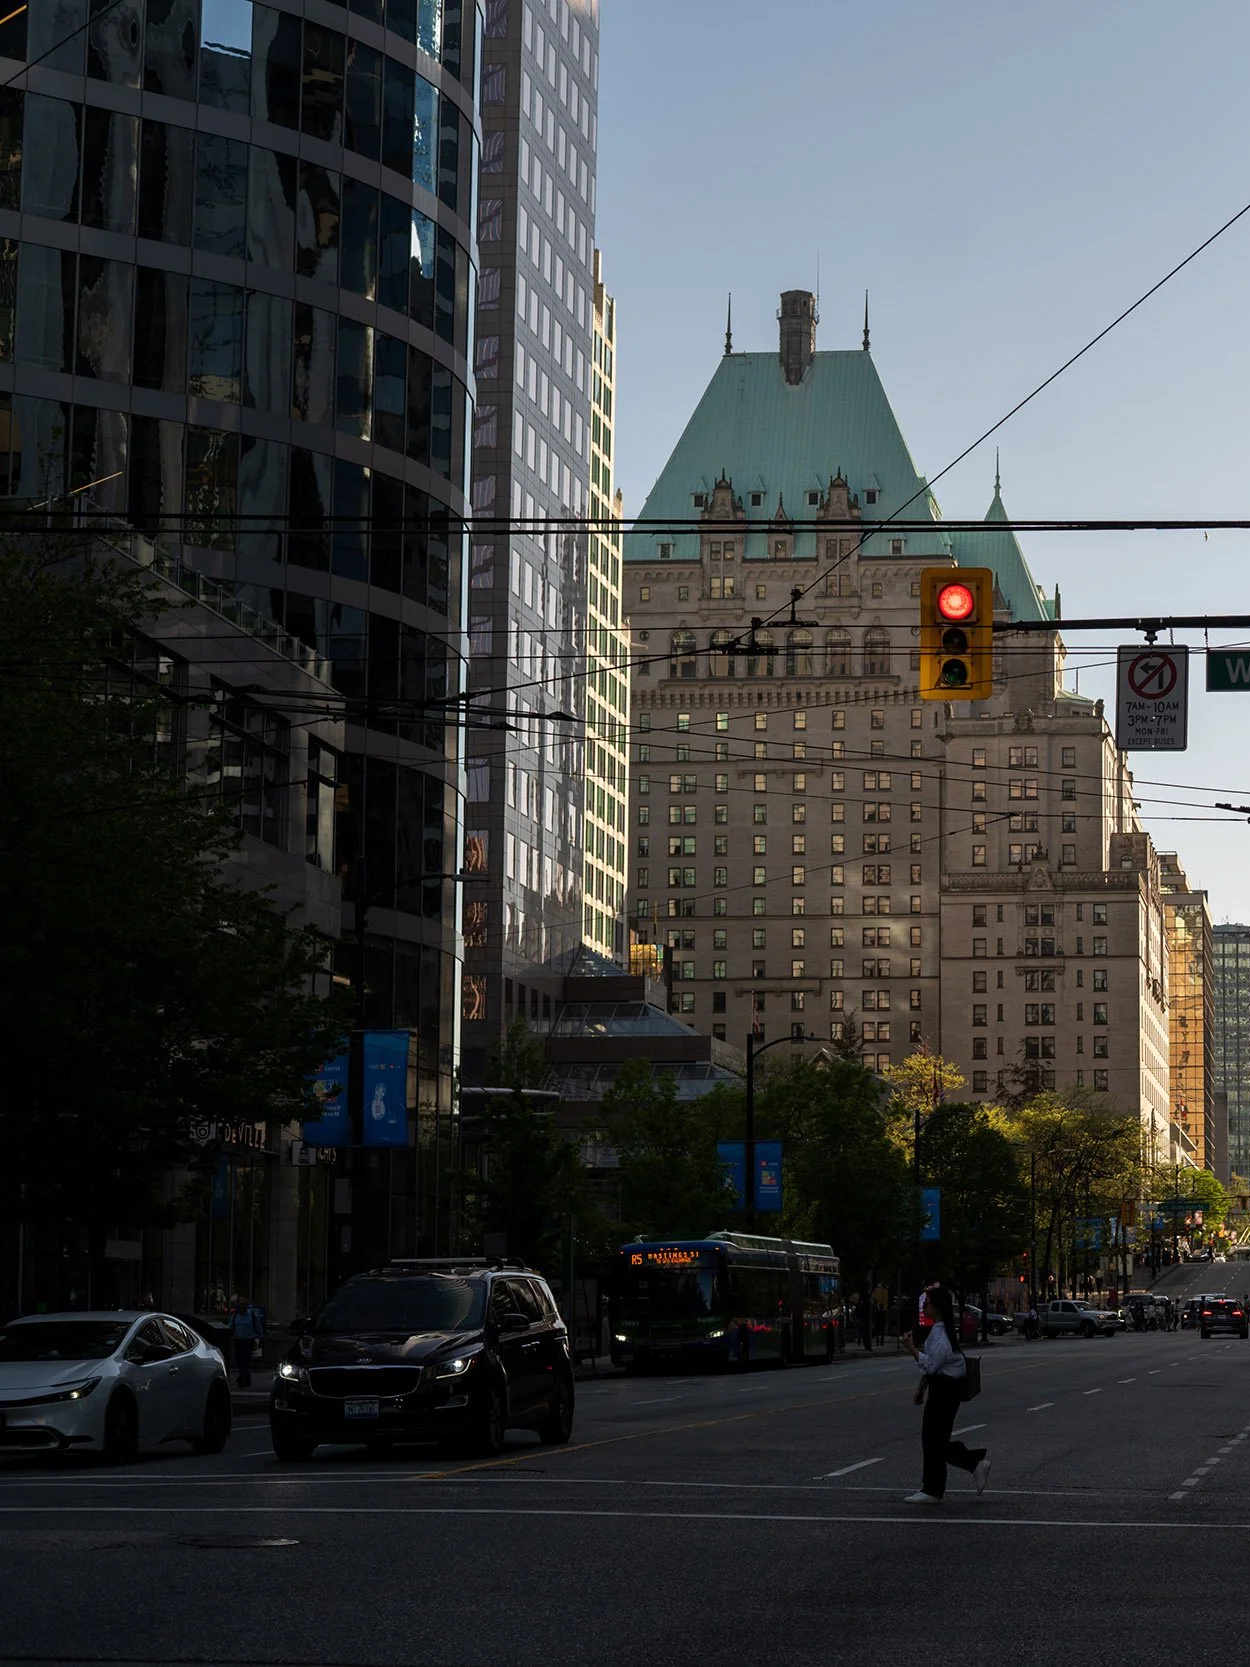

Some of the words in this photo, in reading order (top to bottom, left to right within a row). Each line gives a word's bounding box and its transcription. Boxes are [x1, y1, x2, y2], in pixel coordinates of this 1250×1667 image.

[1135, 727, 1169, 735] MON-FRI
[1127, 737, 1151, 745] EXCEPT
[1154, 737, 1176, 745] BUSES
[647, 1251, 688, 1261] HASTINGS
